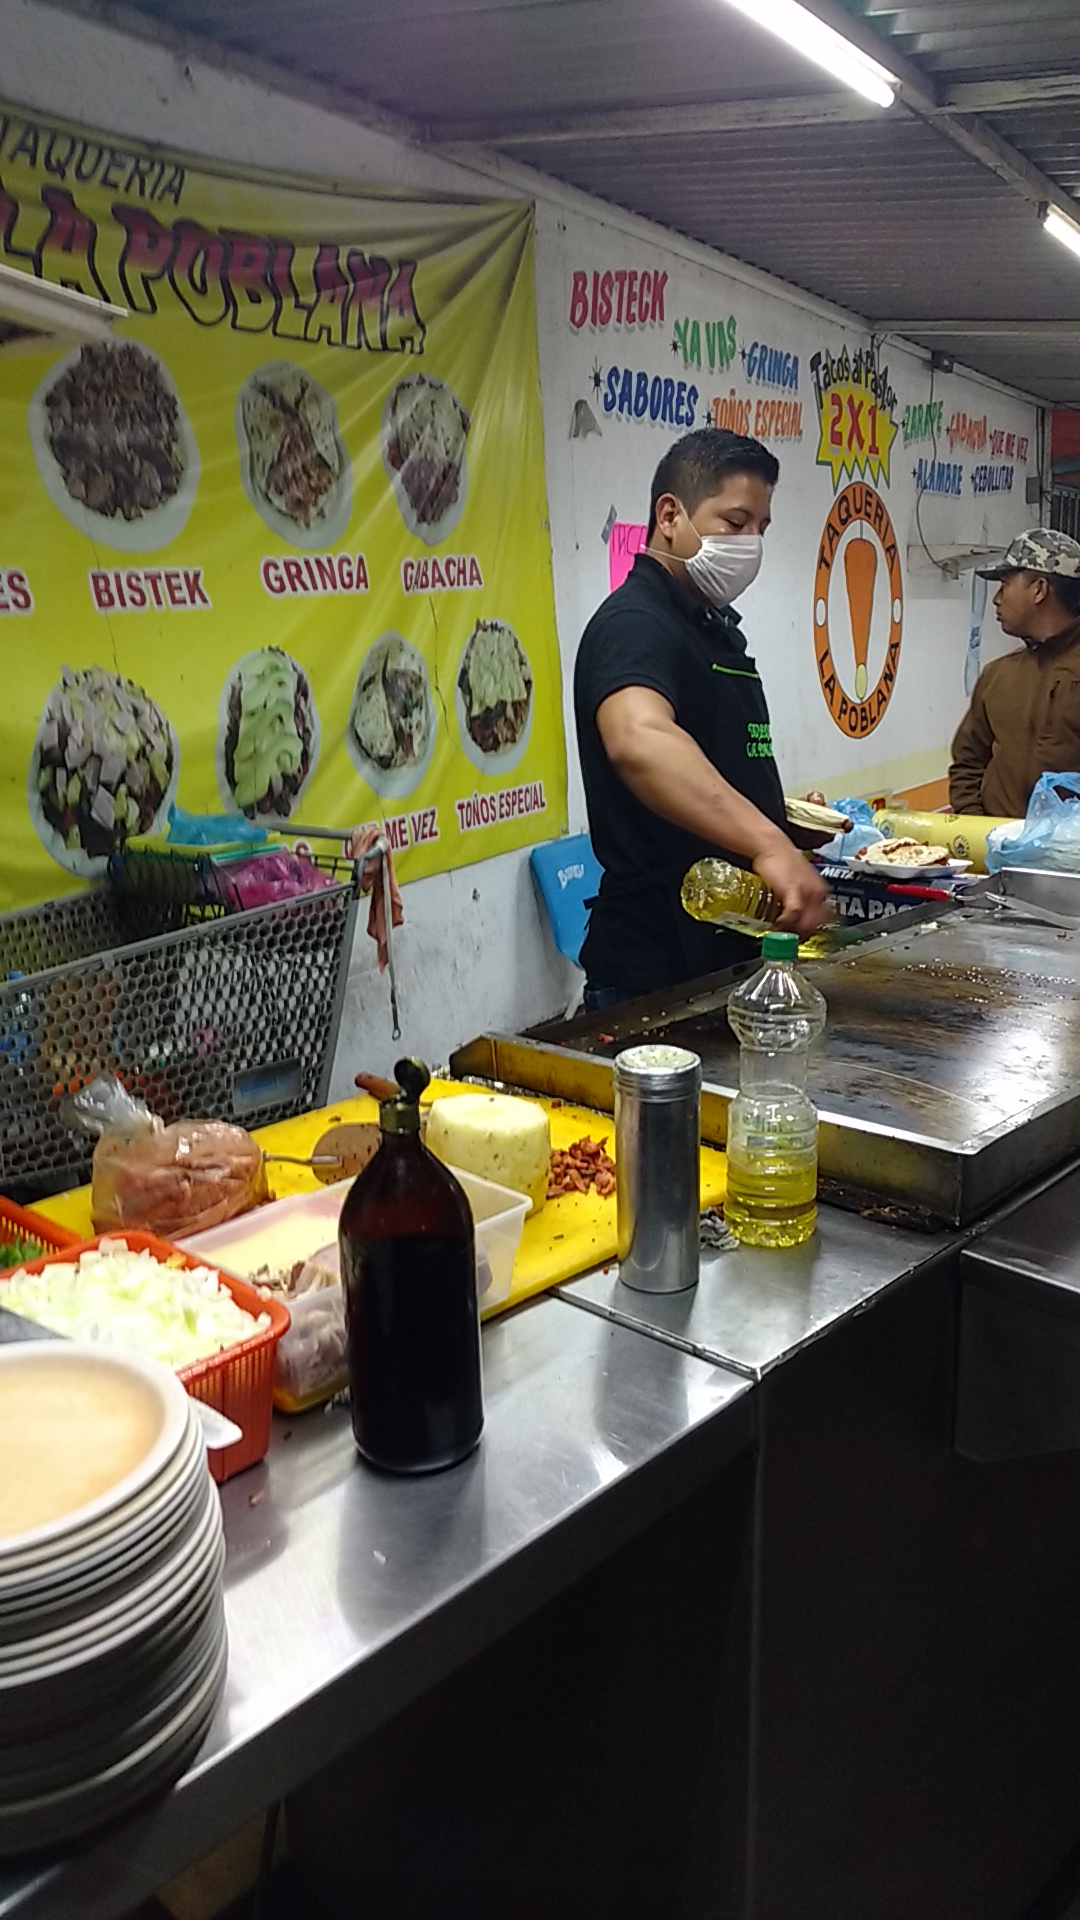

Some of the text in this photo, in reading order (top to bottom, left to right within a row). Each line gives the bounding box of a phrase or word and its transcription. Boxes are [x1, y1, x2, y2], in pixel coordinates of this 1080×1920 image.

[110, 201, 427, 355] POBLANA
[570, 270, 668, 329] BISTECK
[674, 315, 736, 368] YA VAS
[747, 342, 799, 390] GRINGA
[810, 351, 850, 410] Tacos
[604, 366, 698, 427] SABORES
[753, 399, 803, 437] ESPECIAL
[830, 393, 879, 455] 2X1
[916, 458, 963, 495] ALAMBRE
[818, 487, 897, 573] TAQUERIA
[90, 570, 209, 608] BISTEK
[262, 554, 369, 594] GRINGA
[403, 556, 483, 592] GABACHA
[819, 643, 900, 732] LA POBLANA
[411, 808, 438, 843] VEZ
[457, 783, 546, 830] TOÑOS ESPECIAL
[820, 866, 855, 880] META
